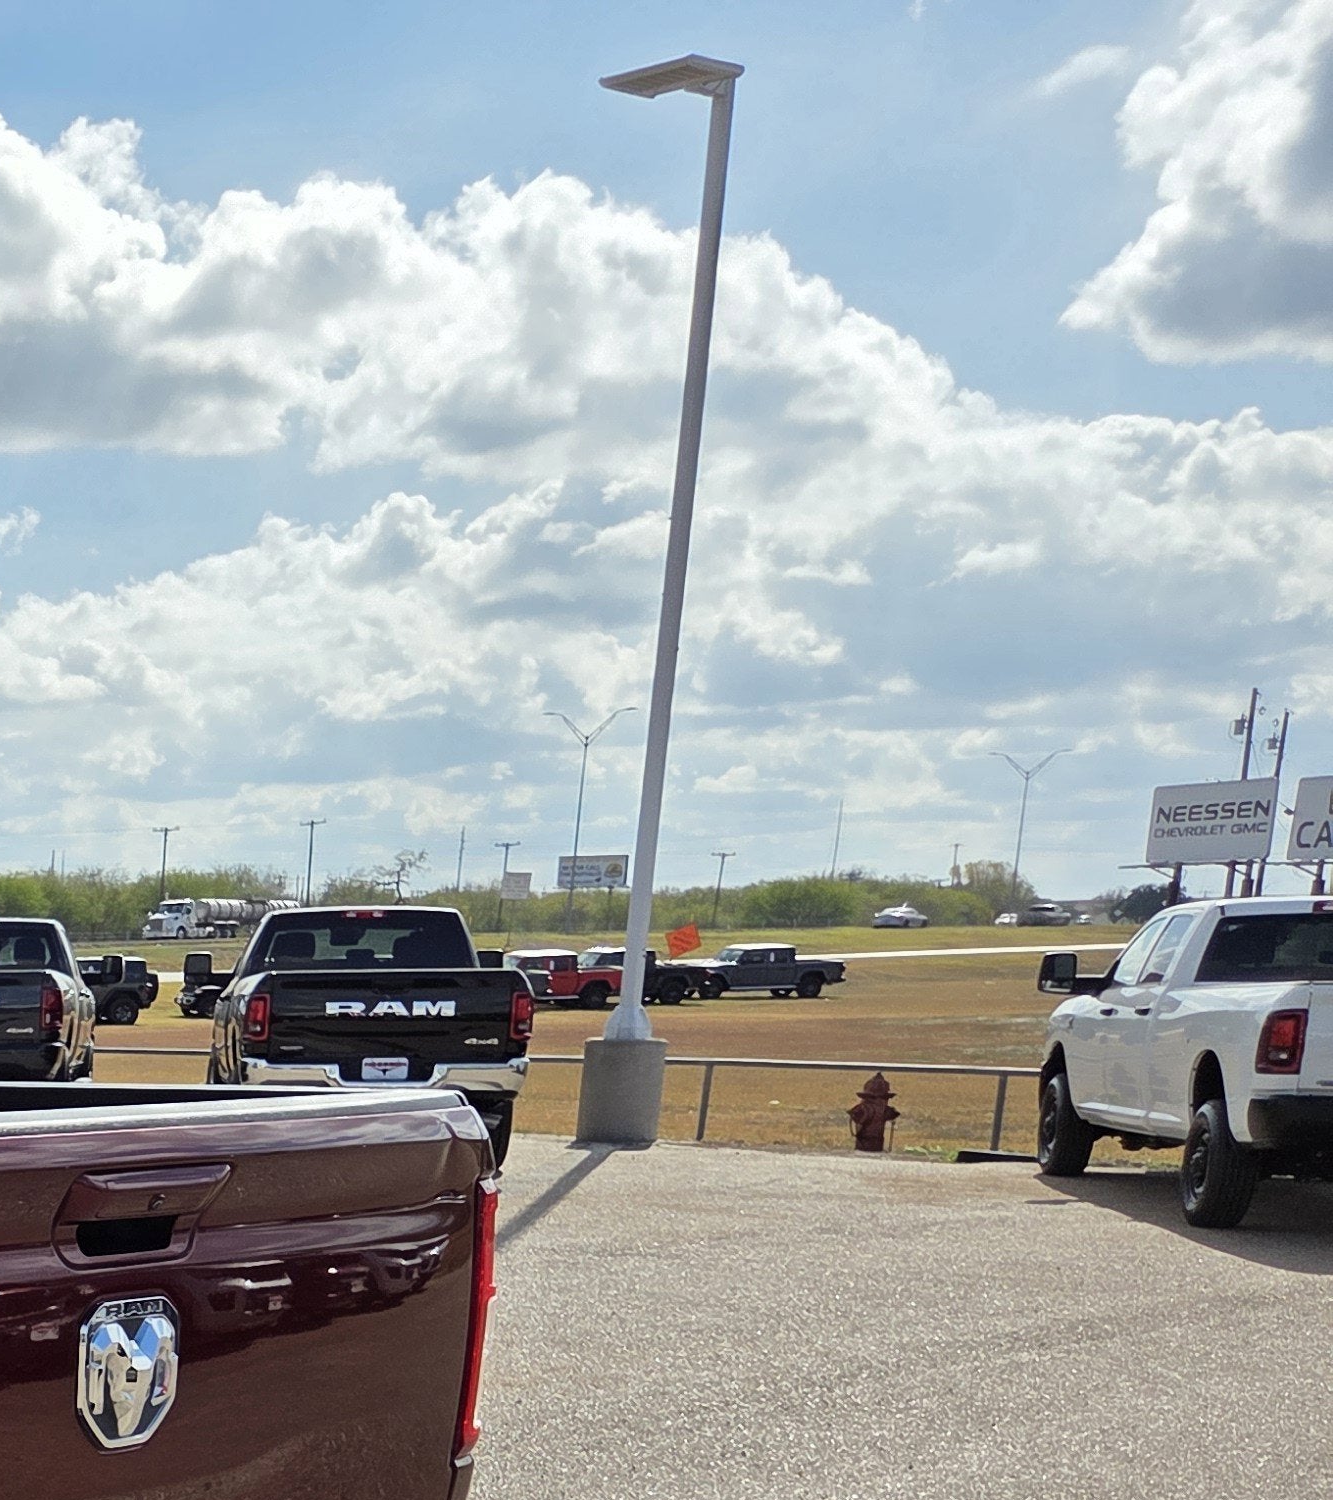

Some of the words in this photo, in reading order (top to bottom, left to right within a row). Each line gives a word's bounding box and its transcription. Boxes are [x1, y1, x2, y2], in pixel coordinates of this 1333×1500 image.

[1155, 800, 1271, 824] NEESSEN
[1153, 824, 1225, 839] CHEVROLET
[1230, 822, 1268, 834] GMC
[325, 1001, 456, 1017] RAM
[105, 1300, 164, 1317] RAM
